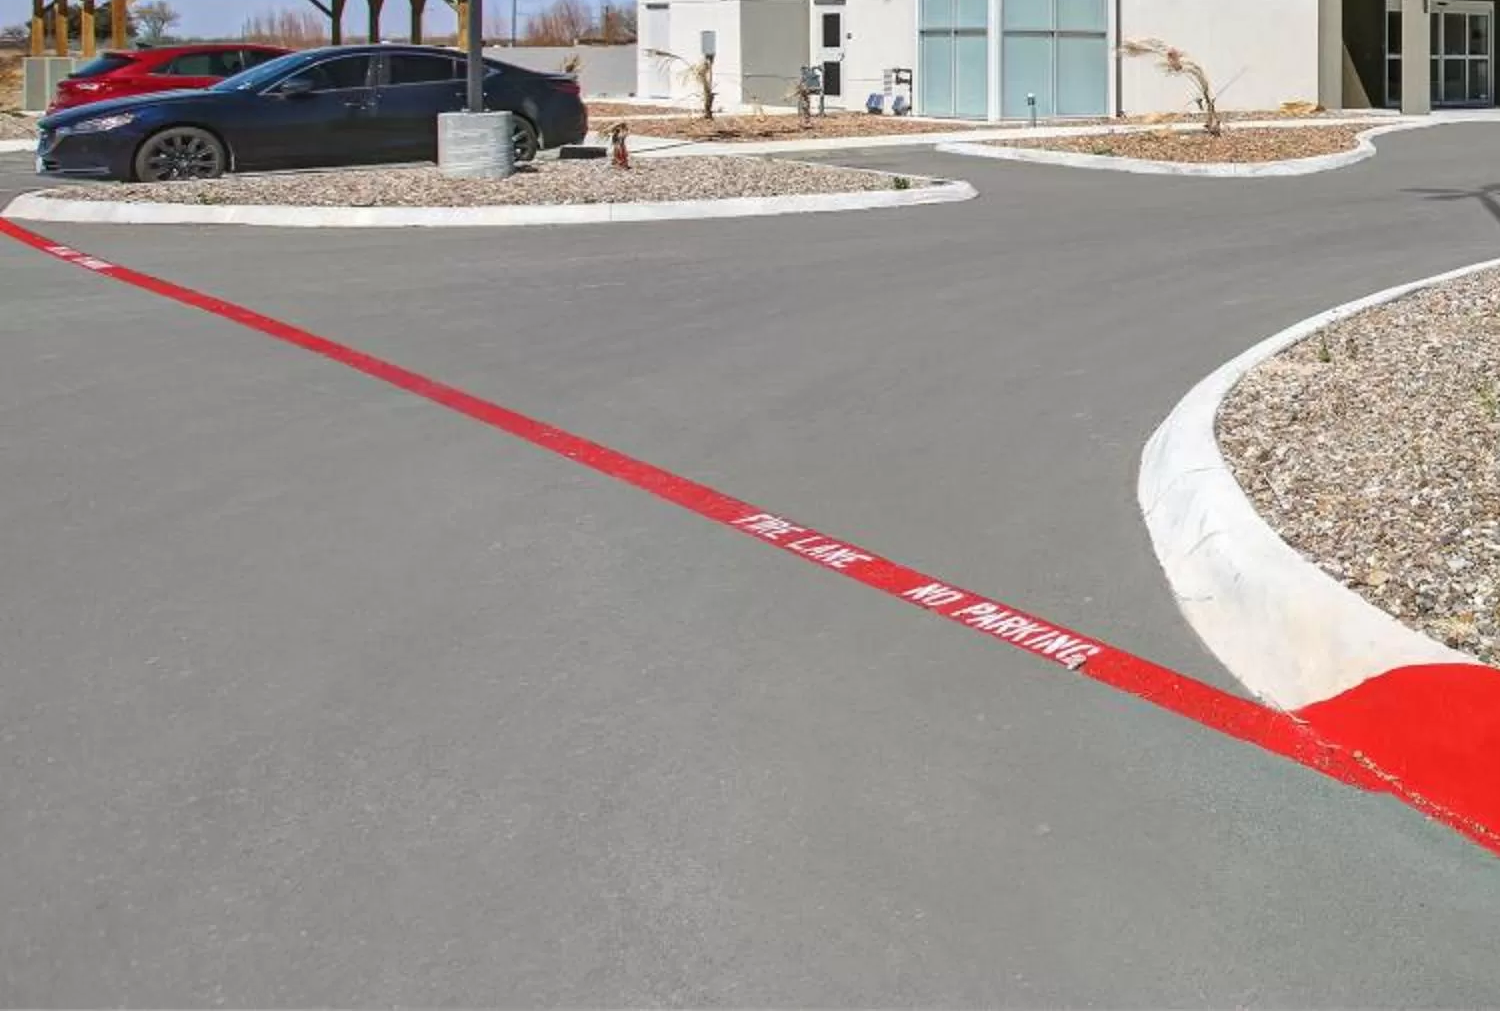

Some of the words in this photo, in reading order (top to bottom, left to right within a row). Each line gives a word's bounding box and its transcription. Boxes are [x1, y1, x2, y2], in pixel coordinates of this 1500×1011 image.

[784, 536, 875, 569] LANE
[902, 582, 965, 607] NO
[951, 601, 1100, 671] PARKING
